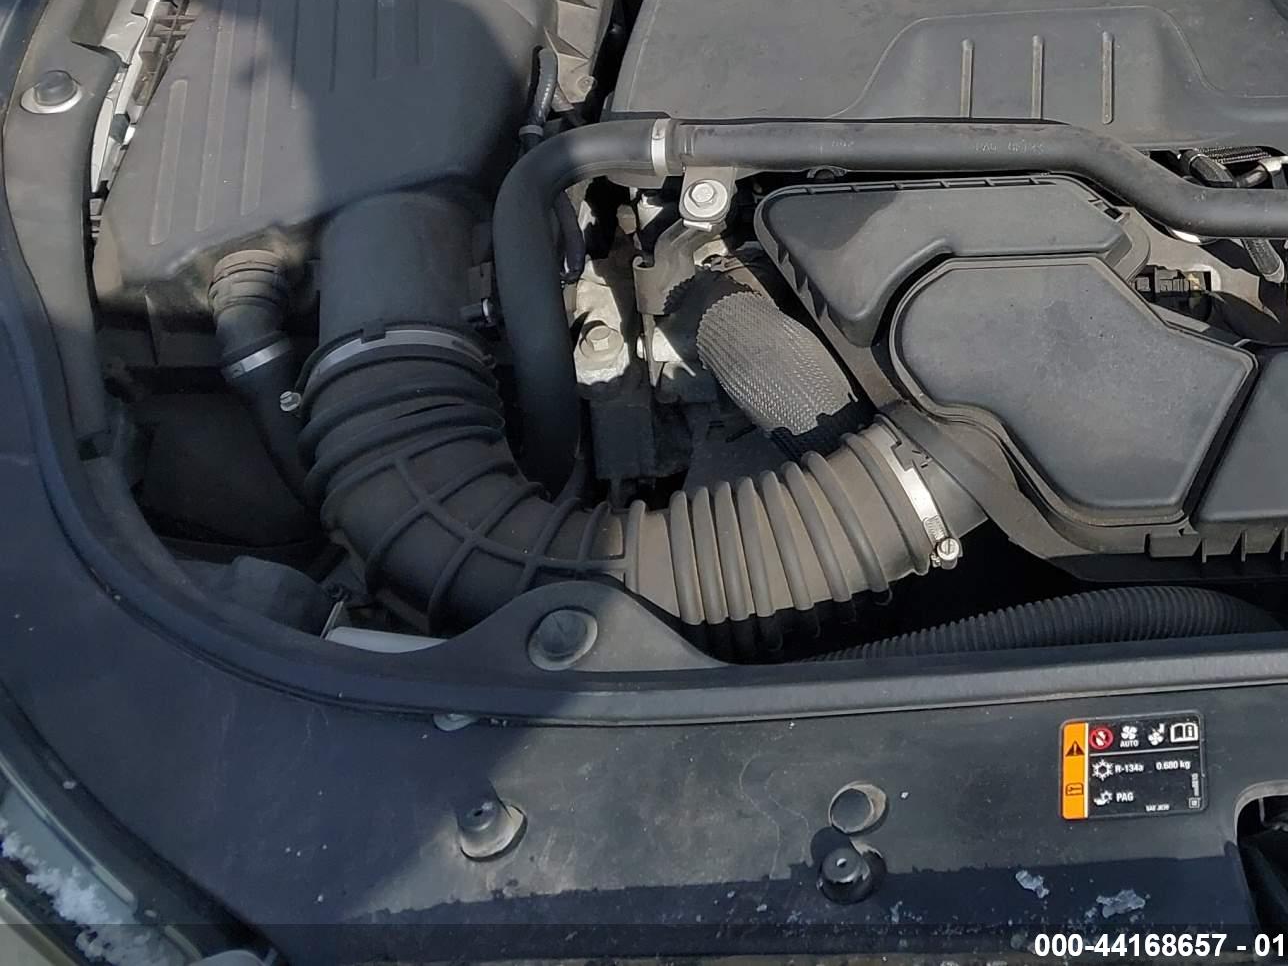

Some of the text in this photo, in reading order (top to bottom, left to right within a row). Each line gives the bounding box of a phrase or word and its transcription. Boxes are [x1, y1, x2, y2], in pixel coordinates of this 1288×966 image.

[1119, 739, 1139, 748] AUTO
[1114, 763, 1144, 773] R-134a
[1179, 759, 1192, 770] kg
[1116, 792, 1135, 803] PAG
